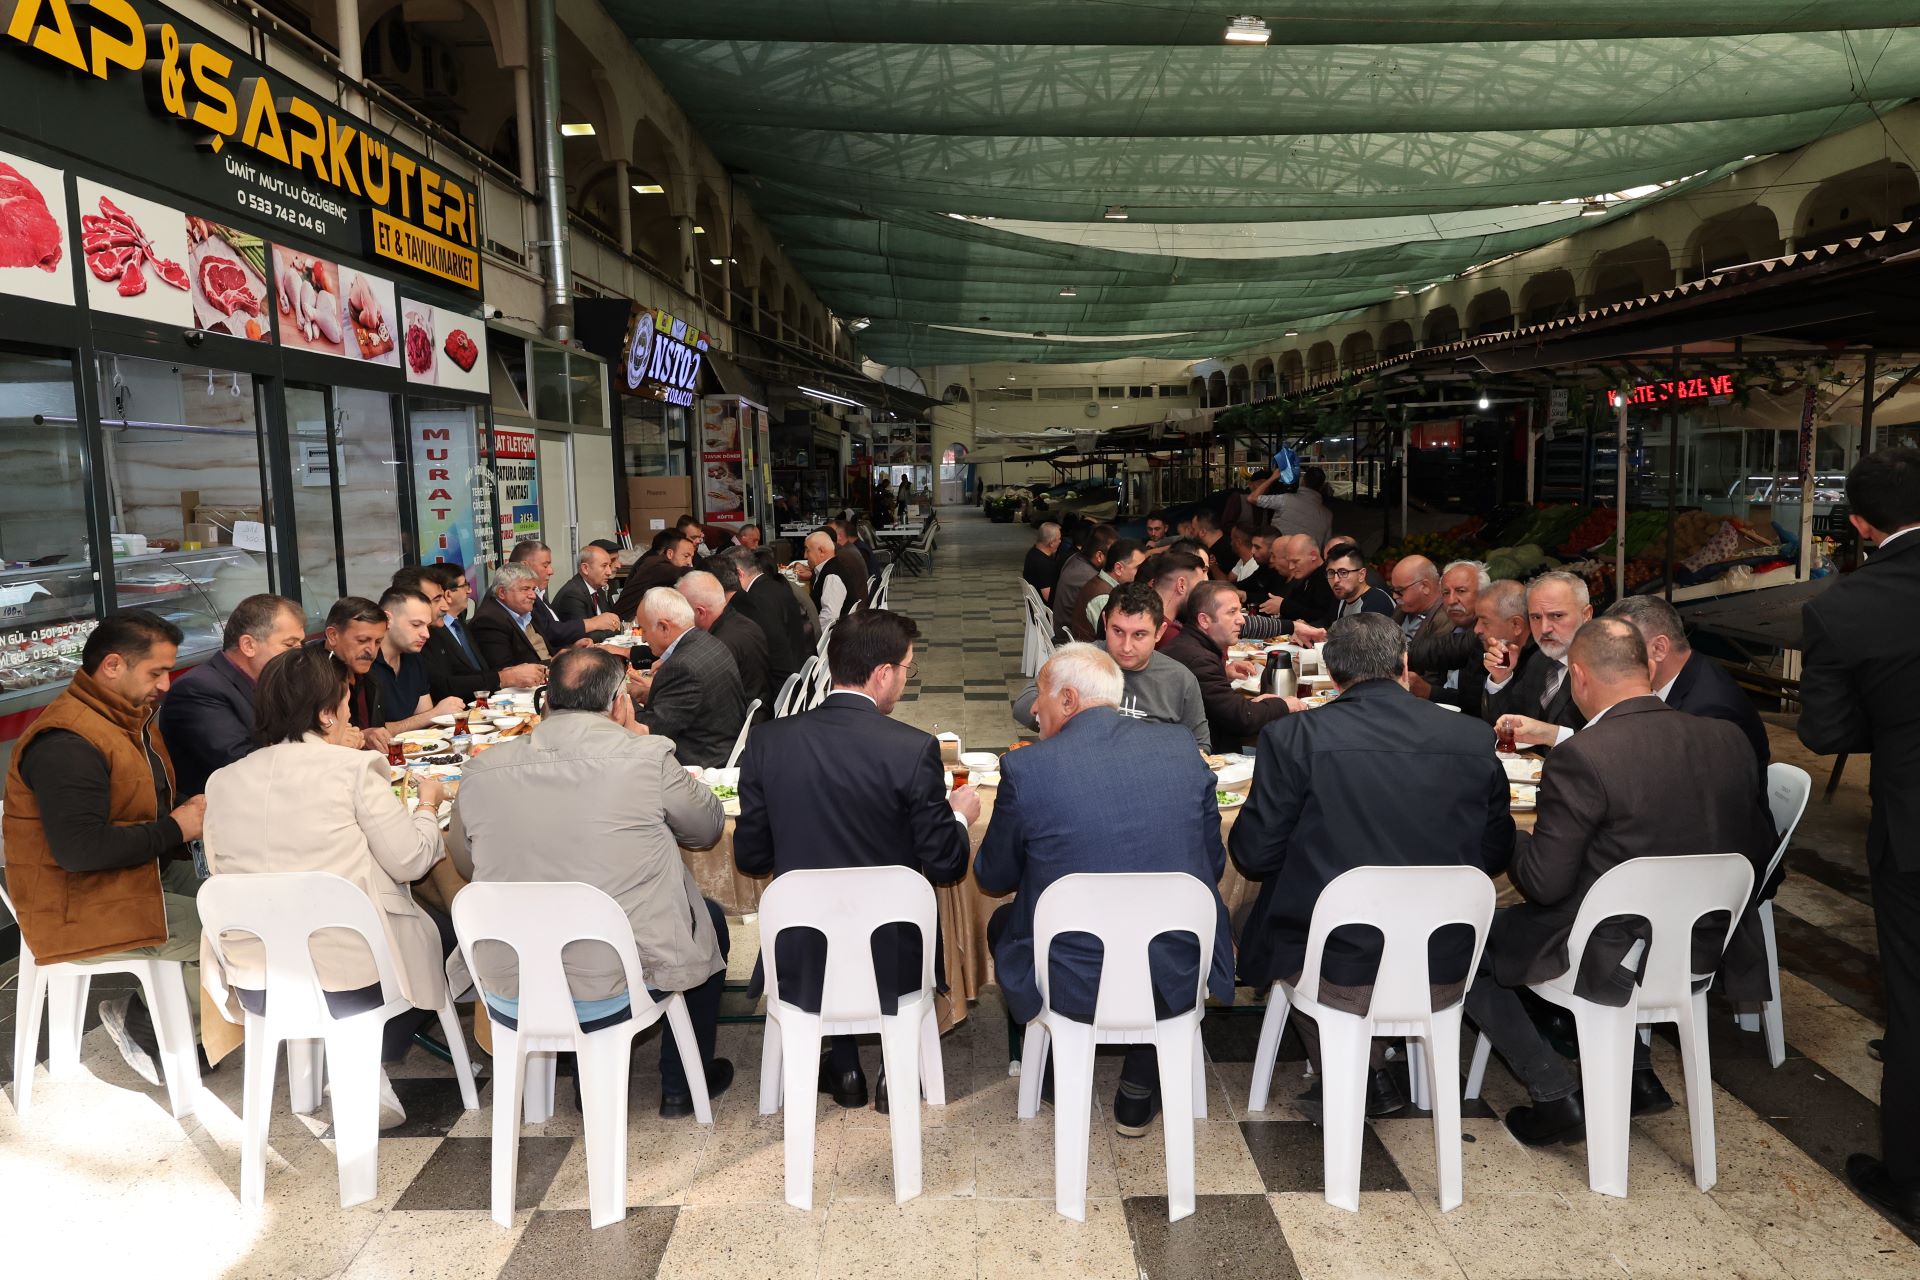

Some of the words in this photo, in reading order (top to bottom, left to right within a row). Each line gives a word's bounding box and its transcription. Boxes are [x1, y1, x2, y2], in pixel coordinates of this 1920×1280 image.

[189, 42, 477, 248] ŞARKÜTERİ
[225, 155, 256, 183] ÜMİT
[301, 187, 348, 224] ÖZÜGENÇ
[237, 190, 246, 205] 0
[249, 193, 273, 215] 533
[275, 204, 297, 223] 742
[298, 213, 313, 230] 04
[315, 220, 326, 235] 61
[378, 221, 391, 252] ET
[395, 229, 404, 256] &
[1710, 374, 1734, 394] VE
[505, 485, 528, 500] NOKTASI
[8, 630, 27, 644] GÜL
[31, 630, 38, 641] 0
[40, 627, 56, 640] 501
[76, 623, 87, 634] 76
[10, 650, 29, 665] GÜL
[33, 649, 40, 660] 0
